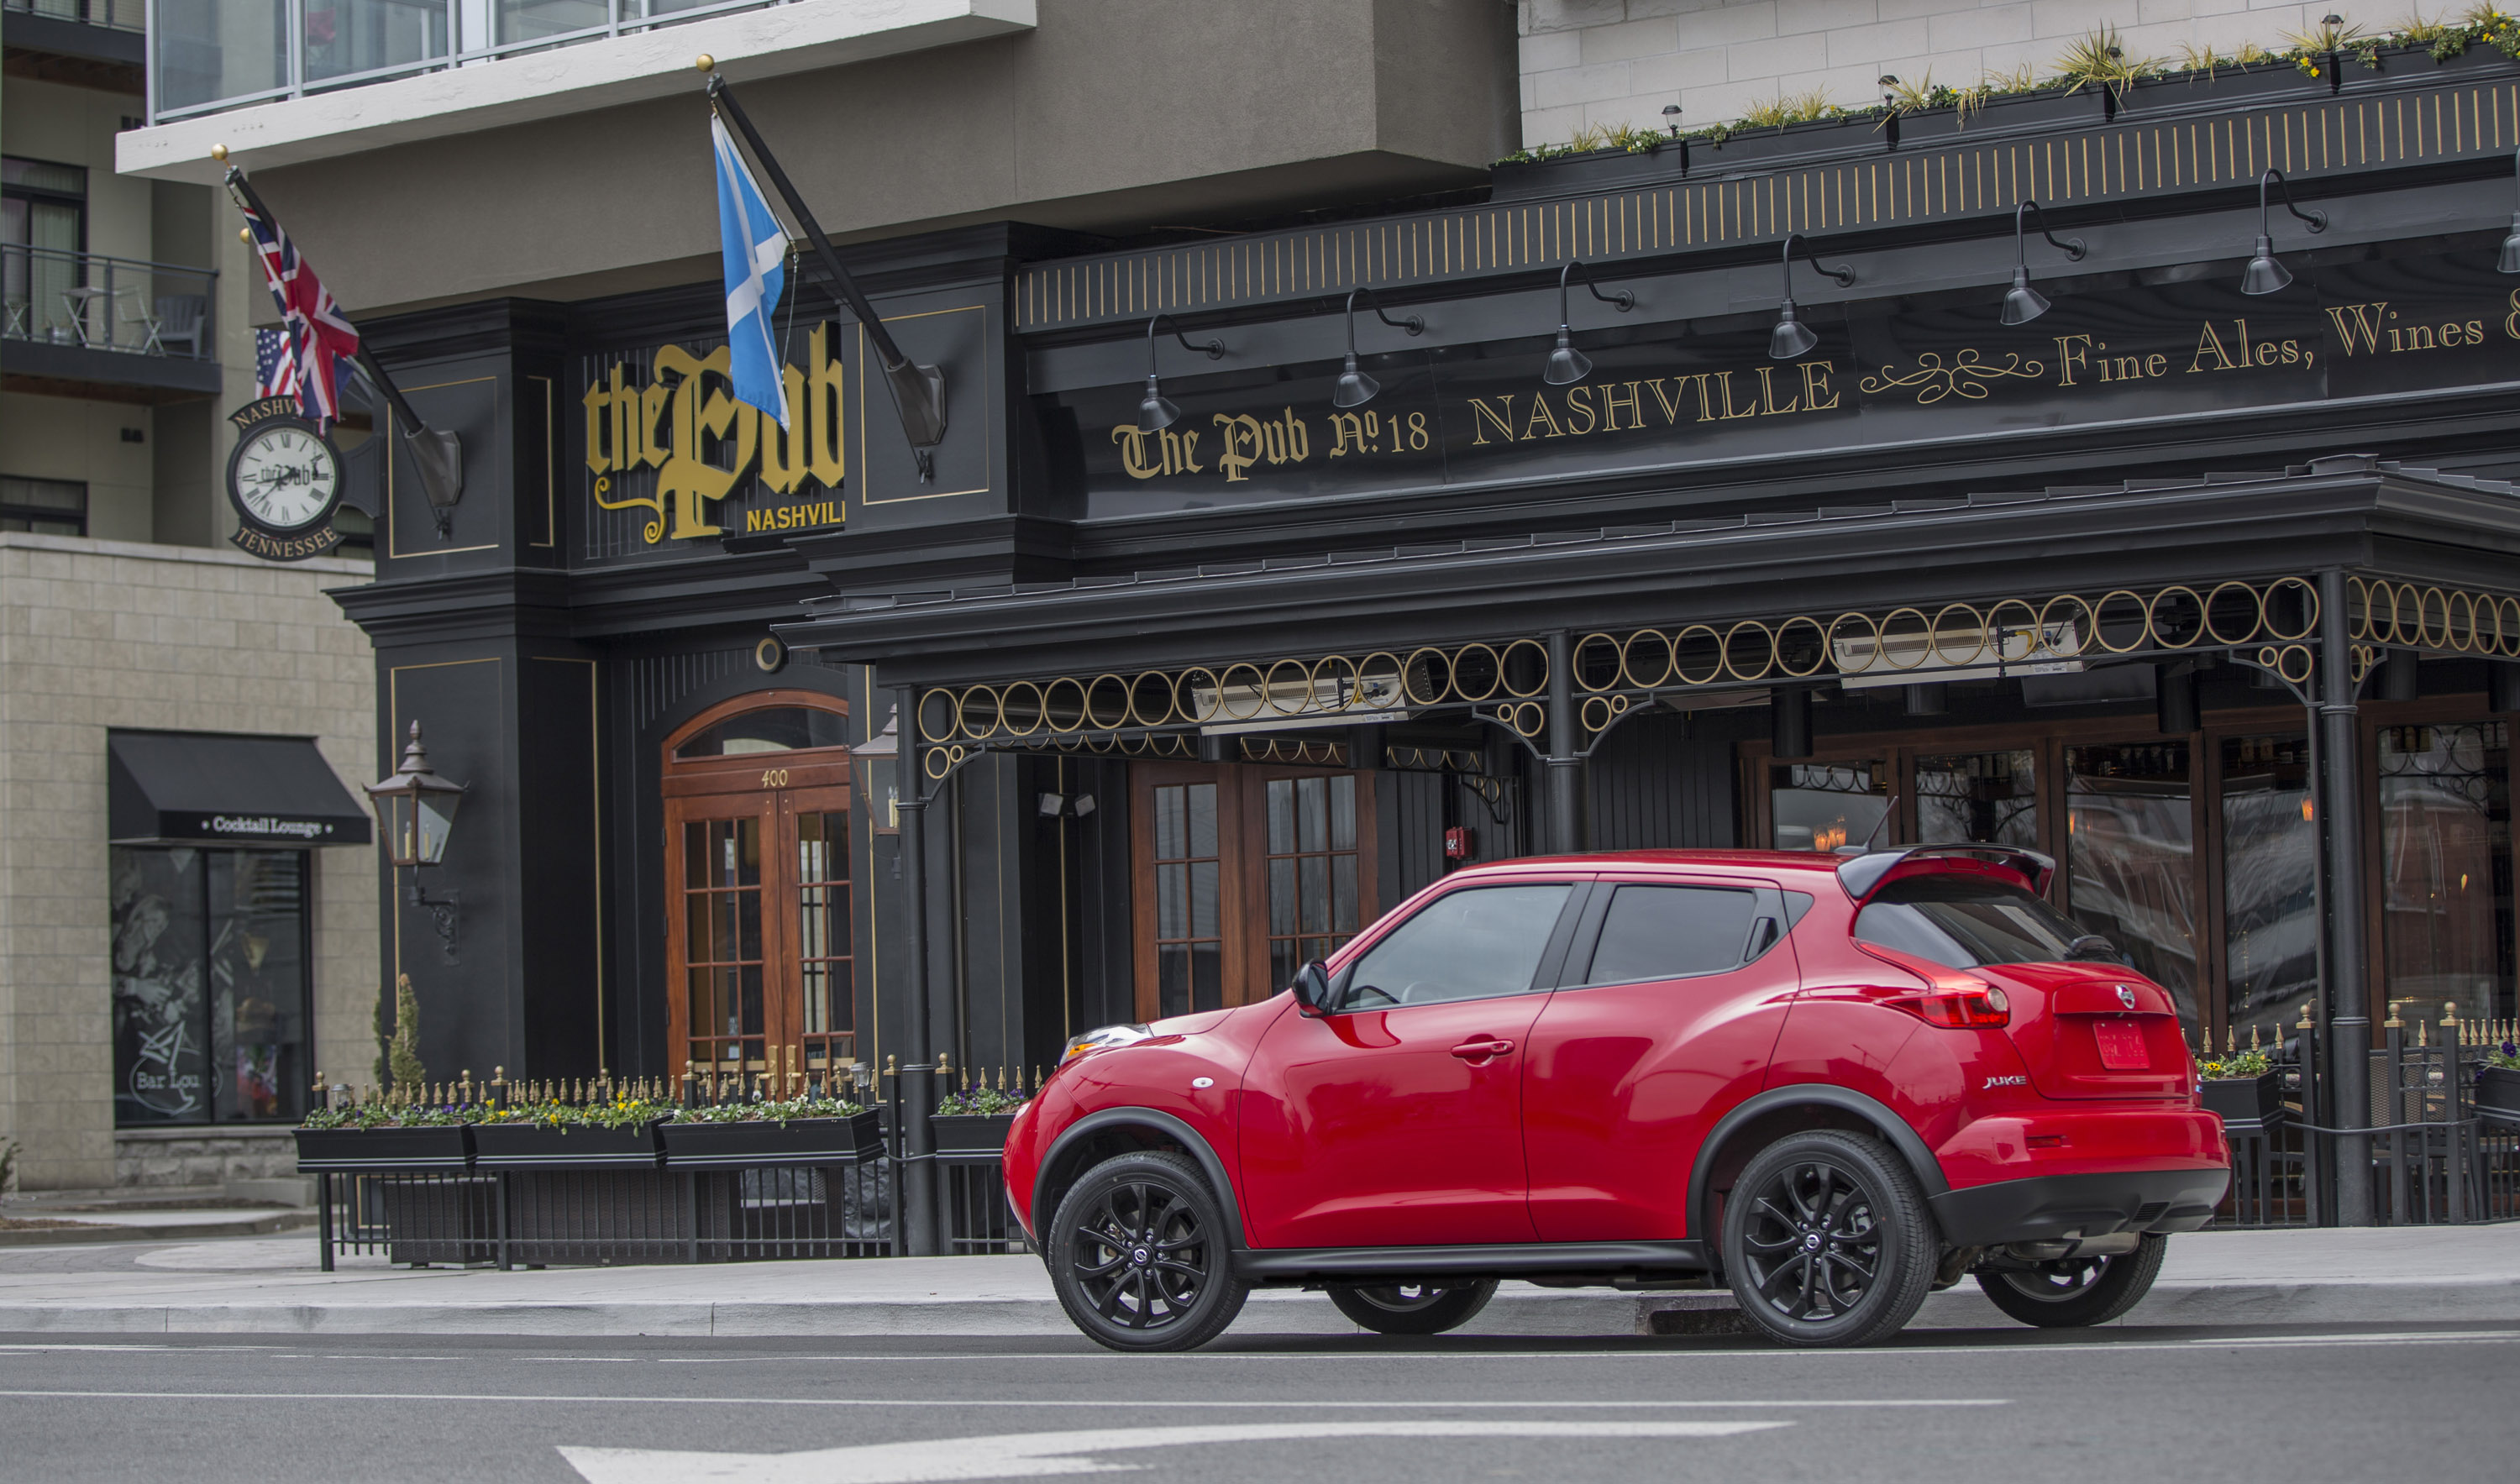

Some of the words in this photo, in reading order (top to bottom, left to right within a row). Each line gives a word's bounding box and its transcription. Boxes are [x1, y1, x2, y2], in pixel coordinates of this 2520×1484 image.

[2052, 333, 2168, 387] Fine
[2186, 317, 2314, 374] Ales,
[2325, 301, 2486, 358] Wines
[1467, 360, 1840, 446] NASHVILLE
[582, 359, 672, 476] the
[653, 319, 845, 540] Pub
[1110, 424, 1204, 480] The
[1212, 405, 1310, 483] Pub
[236, 527, 338, 558] TENNESSEE
[761, 768, 789, 789] 400
[213, 815, 269, 834] Cocktail
[270, 818, 323, 838] Lounge
[136, 1072, 166, 1089] Bar
[1982, 1075, 2027, 1089] JUKE
